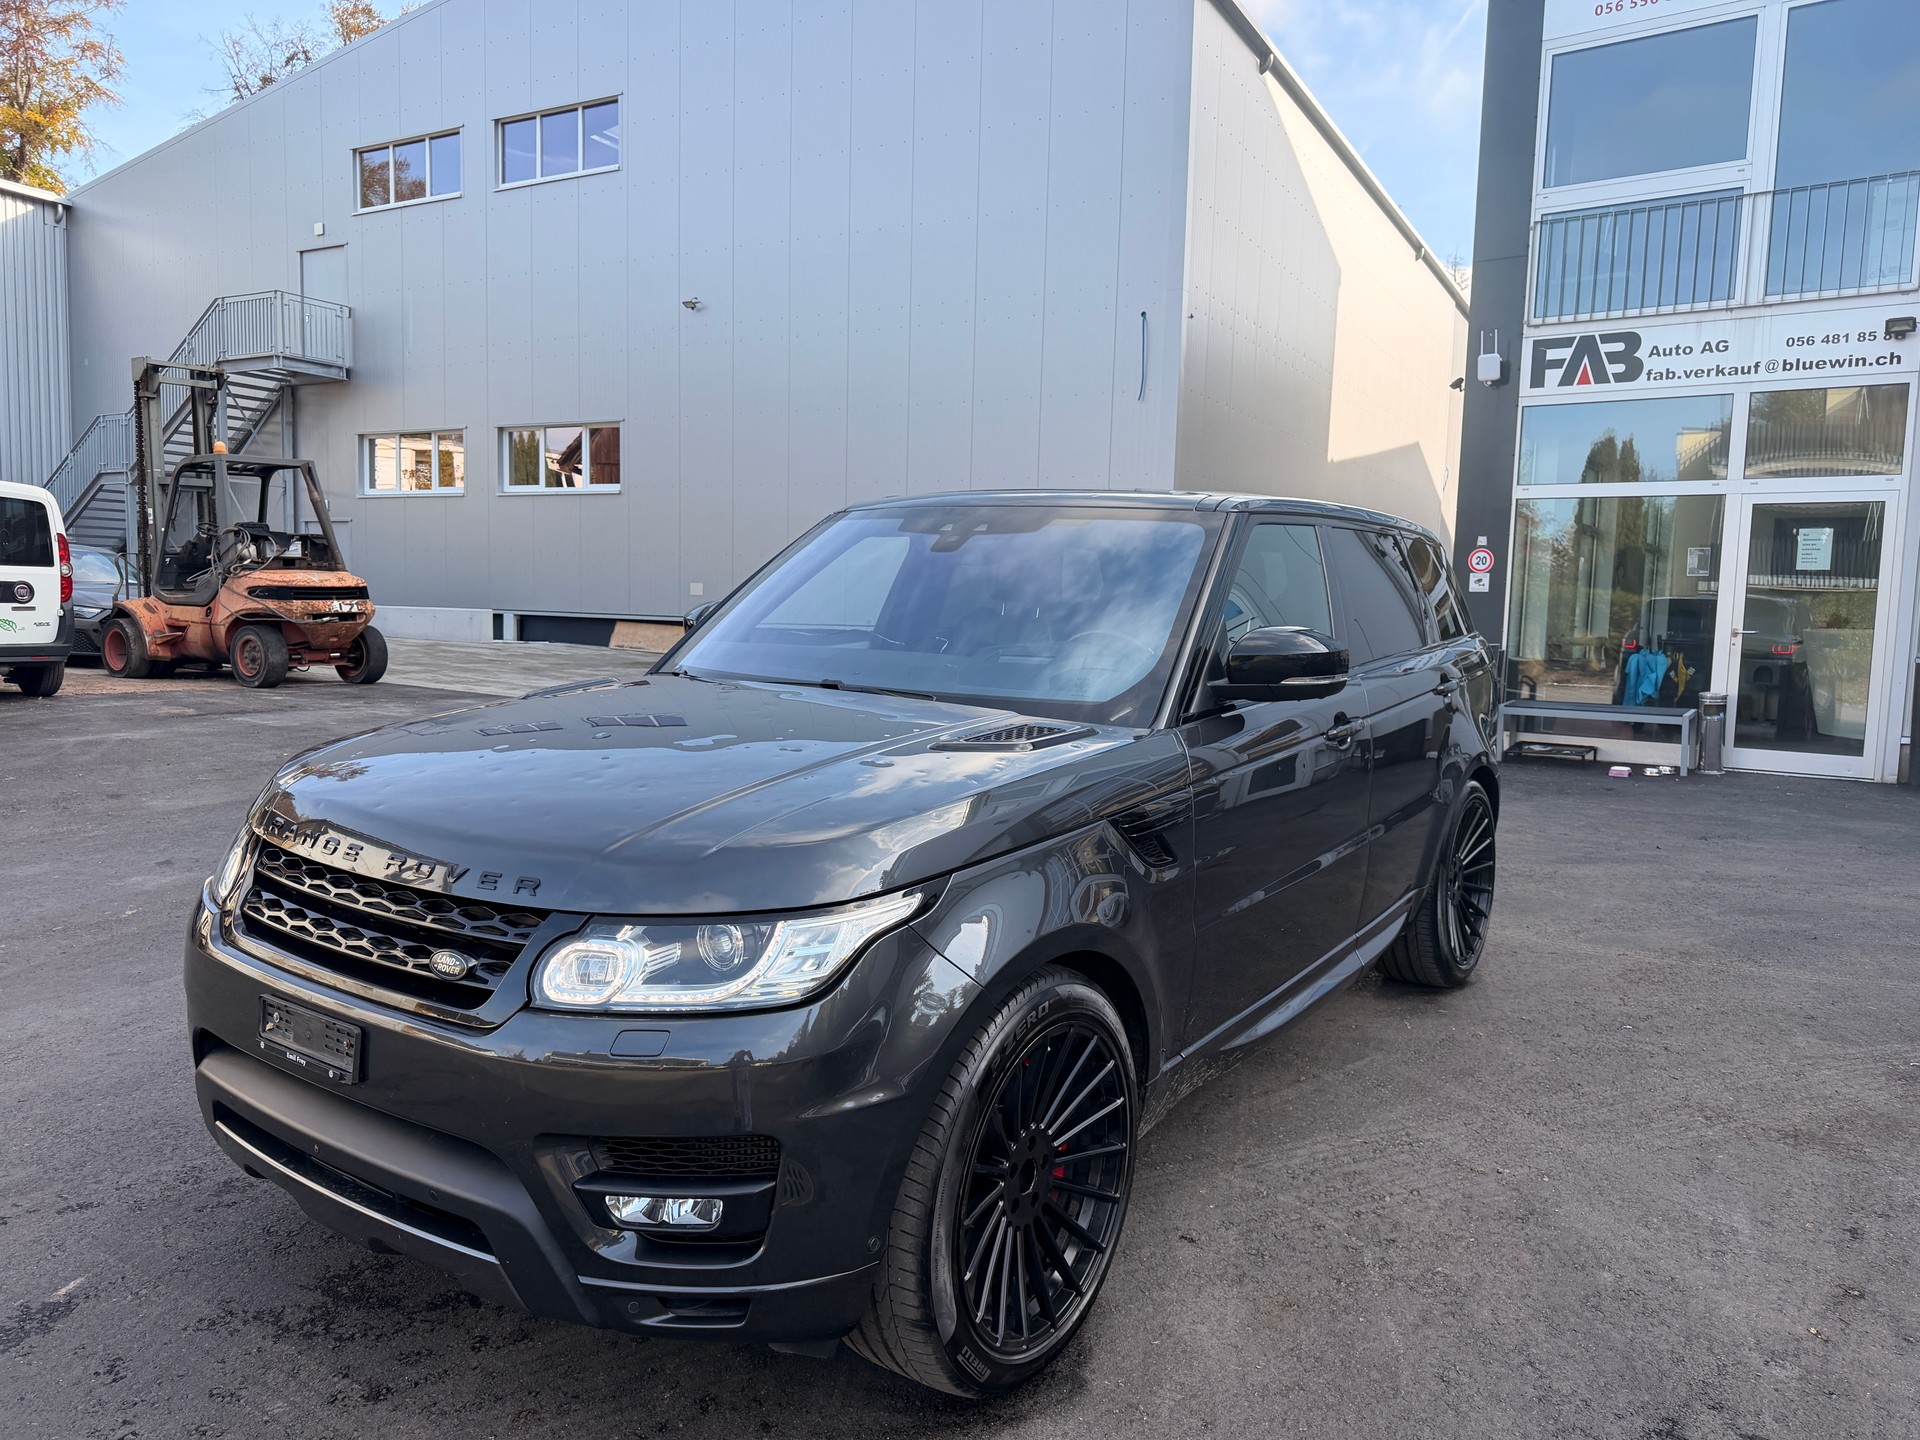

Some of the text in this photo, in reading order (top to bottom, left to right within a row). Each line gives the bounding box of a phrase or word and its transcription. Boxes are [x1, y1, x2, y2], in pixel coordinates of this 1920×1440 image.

[1594, 0, 1624, 16] 056
[1786, 335, 1815, 347] 056
[1821, 333, 1850, 345] 481
[1857, 331, 1877, 342] 85
[1648, 339, 1729, 358] Auto AG
[1530, 331, 1644, 389] FAB
[1475, 556, 1487, 566] 20
[269, 816, 541, 896] RANGE ROVER
[436, 954, 456, 966] LAND
[437, 963, 461, 976] ROVER
[1004, 1001, 1050, 1056] ZERO
[957, 1345, 992, 1383] PIRELLI
